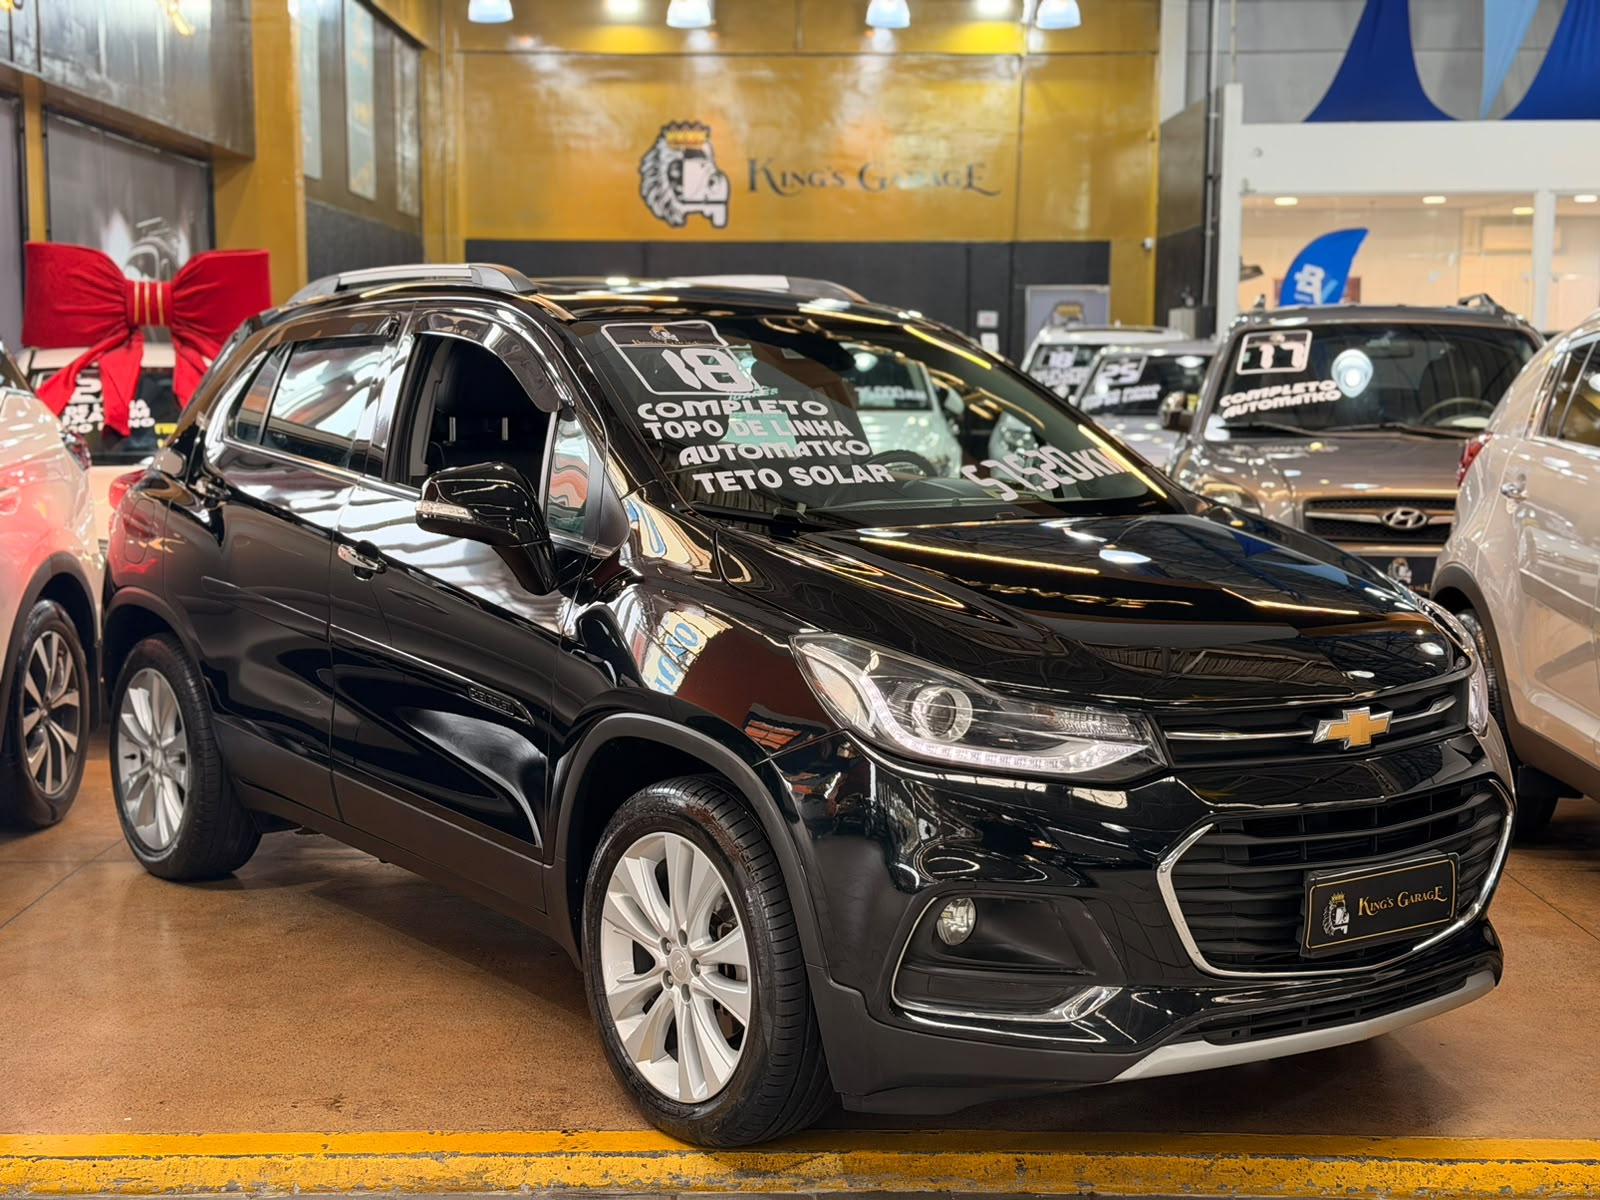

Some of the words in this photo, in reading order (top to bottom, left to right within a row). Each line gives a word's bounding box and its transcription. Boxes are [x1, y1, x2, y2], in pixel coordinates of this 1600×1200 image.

[661, 348, 754, 392] 18
[1219, 380, 1337, 407] COMPLETO
[637, 399, 829, 421] COMPLETO
[643, 420, 724, 441] TOPO
[729, 420, 760, 437] DE
[773, 420, 854, 437] LINHA
[679, 440, 872, 467] AUTOMATICO
[693, 467, 783, 494] TETO
[787, 464, 896, 487] SOLAR
